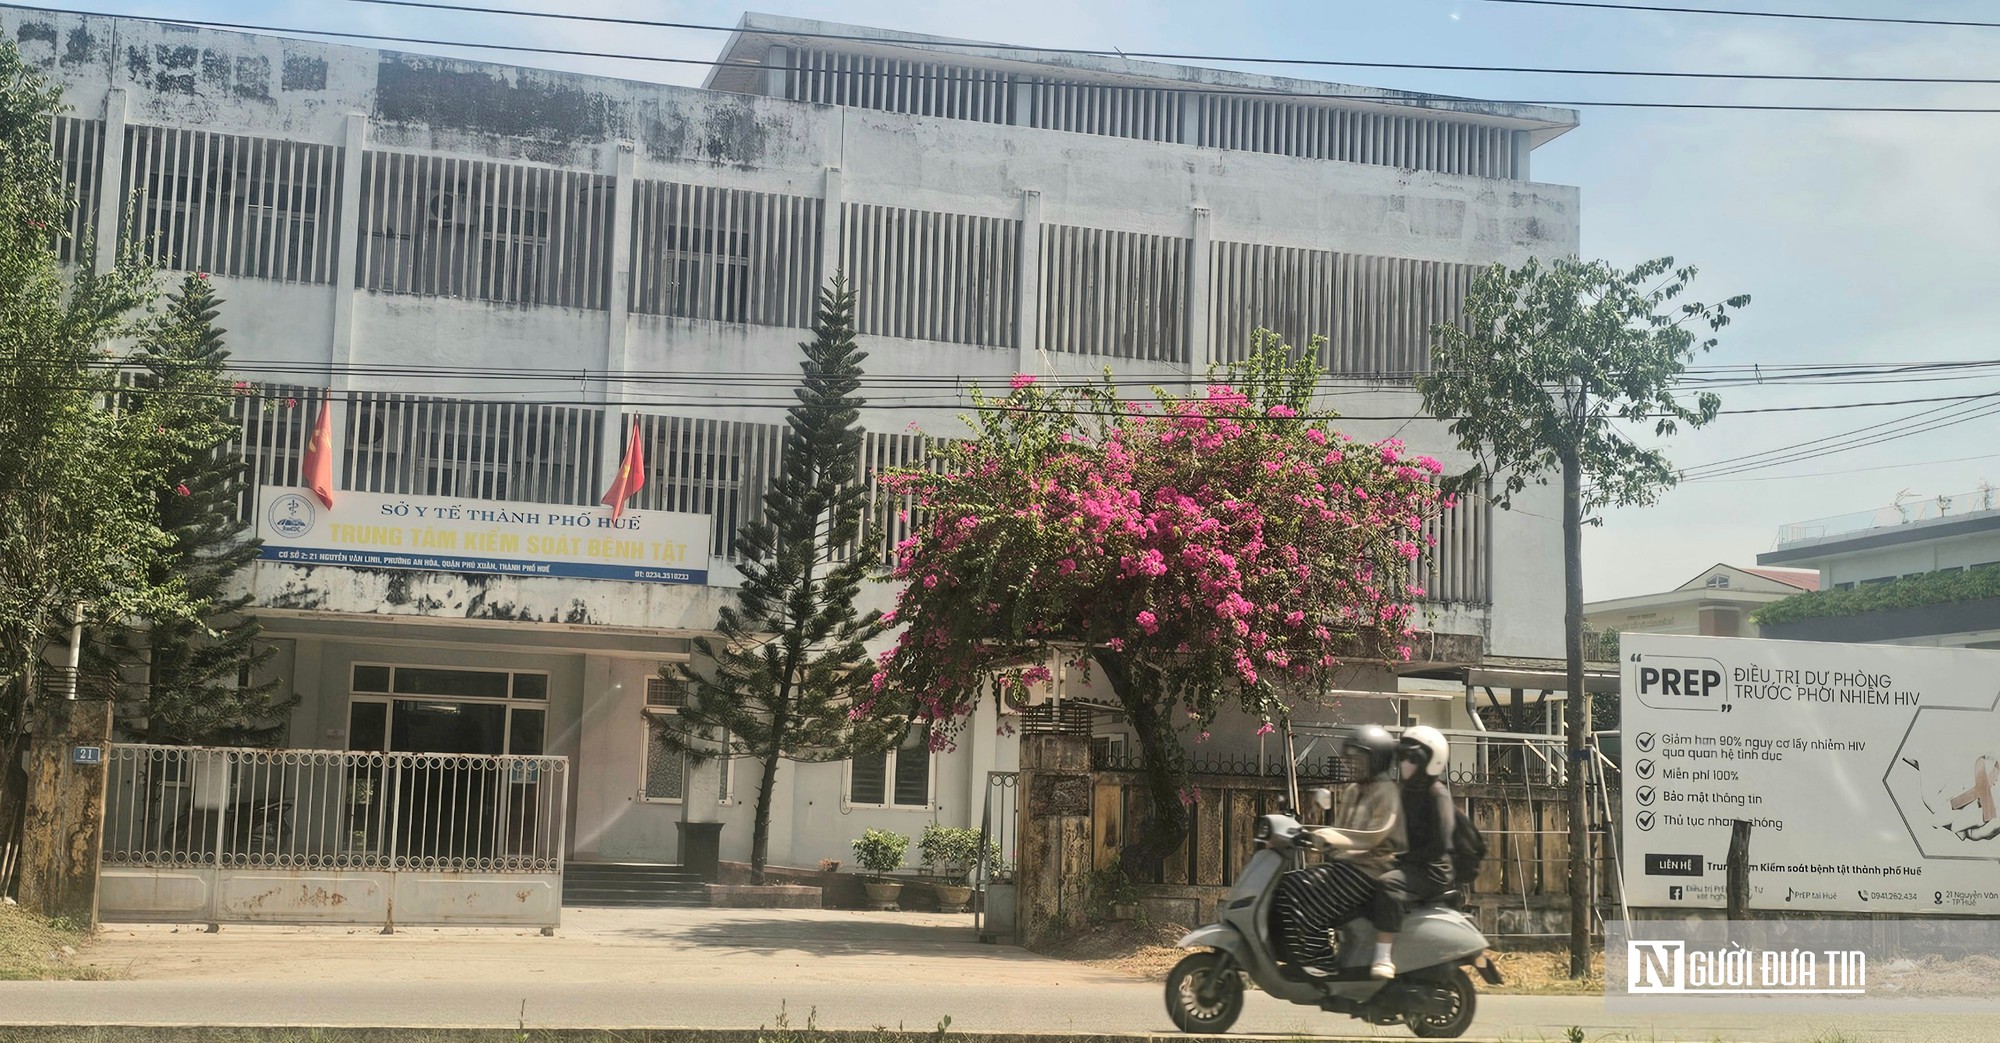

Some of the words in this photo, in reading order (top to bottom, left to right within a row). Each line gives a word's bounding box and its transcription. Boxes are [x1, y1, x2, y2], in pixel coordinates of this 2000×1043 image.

[381, 501, 409, 516] SỞ
[415, 506, 428, 517] Y
[433, 504, 462, 520] TẾ
[467, 508, 540, 525] THÀNH
[549, 511, 591, 527] PHỐ
[597, 515, 641, 531] HUẾ
[329, 523, 402, 546] TRUNG
[410, 527, 457, 549] TÂM
[464, 529, 519, 553] KIỂM
[527, 534, 582, 556] SOÁT
[588, 536, 644, 561] BỆNH
[651, 540, 688, 566] TẬT
[290, 550, 300, 559] SỞ
[309, 552, 317, 560] 21
[320, 552, 347, 561] NGUYỄN
[384, 556, 411, 565] PHƯỜNG
[412, 558, 422, 566] AN
[442, 560, 460, 569] QUẬN
[462, 560, 476, 569] PHÚ
[500, 562, 521, 571] THÀNH
[522, 564, 536, 573] PHỐ
[537, 565, 550, 573] HUẾ
[1640, 667, 1721, 697] PREP
[1734, 663, 1770, 682] ĐIỀU
[1776, 670, 1799, 687] TRỊ
[1806, 670, 1830, 689] DỰ
[1834, 670, 1892, 689] PHÒNG
[1734, 681, 1792, 700] TRƯỚC
[1840, 685, 1889, 705] NHIỄM
[1895, 691, 1920, 706] HIV
[1662, 733, 1692, 745] Giảm
[1719, 736, 1742, 747] 90%
[1745, 738, 1772, 751] nguy
[1776, 739, 1790, 749] cơ
[1810, 739, 1845, 751] nhiễm
[1848, 741, 1866, 751] HIV
[80, 749, 92, 759] 21
[1662, 749, 1685, 760] qua
[1688, 749, 1718, 761] quan
[1721, 748, 1734, 761] hệ
[1663, 767, 1689, 780] Miễn
[1692, 769, 1710, 782] phí
[1713, 770, 1738, 781] 100%
[1664, 791, 1684, 802] Bảo
[1687, 792, 1709, 803] mật
[1712, 792, 1745, 806] thông
[1748, 793, 1762, 804] tin
[1664, 814, 1684, 826] Thủ
[1687, 816, 1704, 828] tục
[1660, 858, 1678, 870] LIÊN
[1680, 858, 1692, 871] HỆ
[1708, 862, 1728, 872] Trun
[1760, 862, 1786, 873] Kiểm
[1788, 864, 1808, 873] soát
[1810, 864, 1834, 875] bệnh
[1837, 864, 1850, 876] tật
[1852, 864, 1881, 875] thành
[1883, 865, 1901, 877] phố
[1903, 865, 1922, 876] Huế
[1954, 890, 1982, 901] Nguyễn
